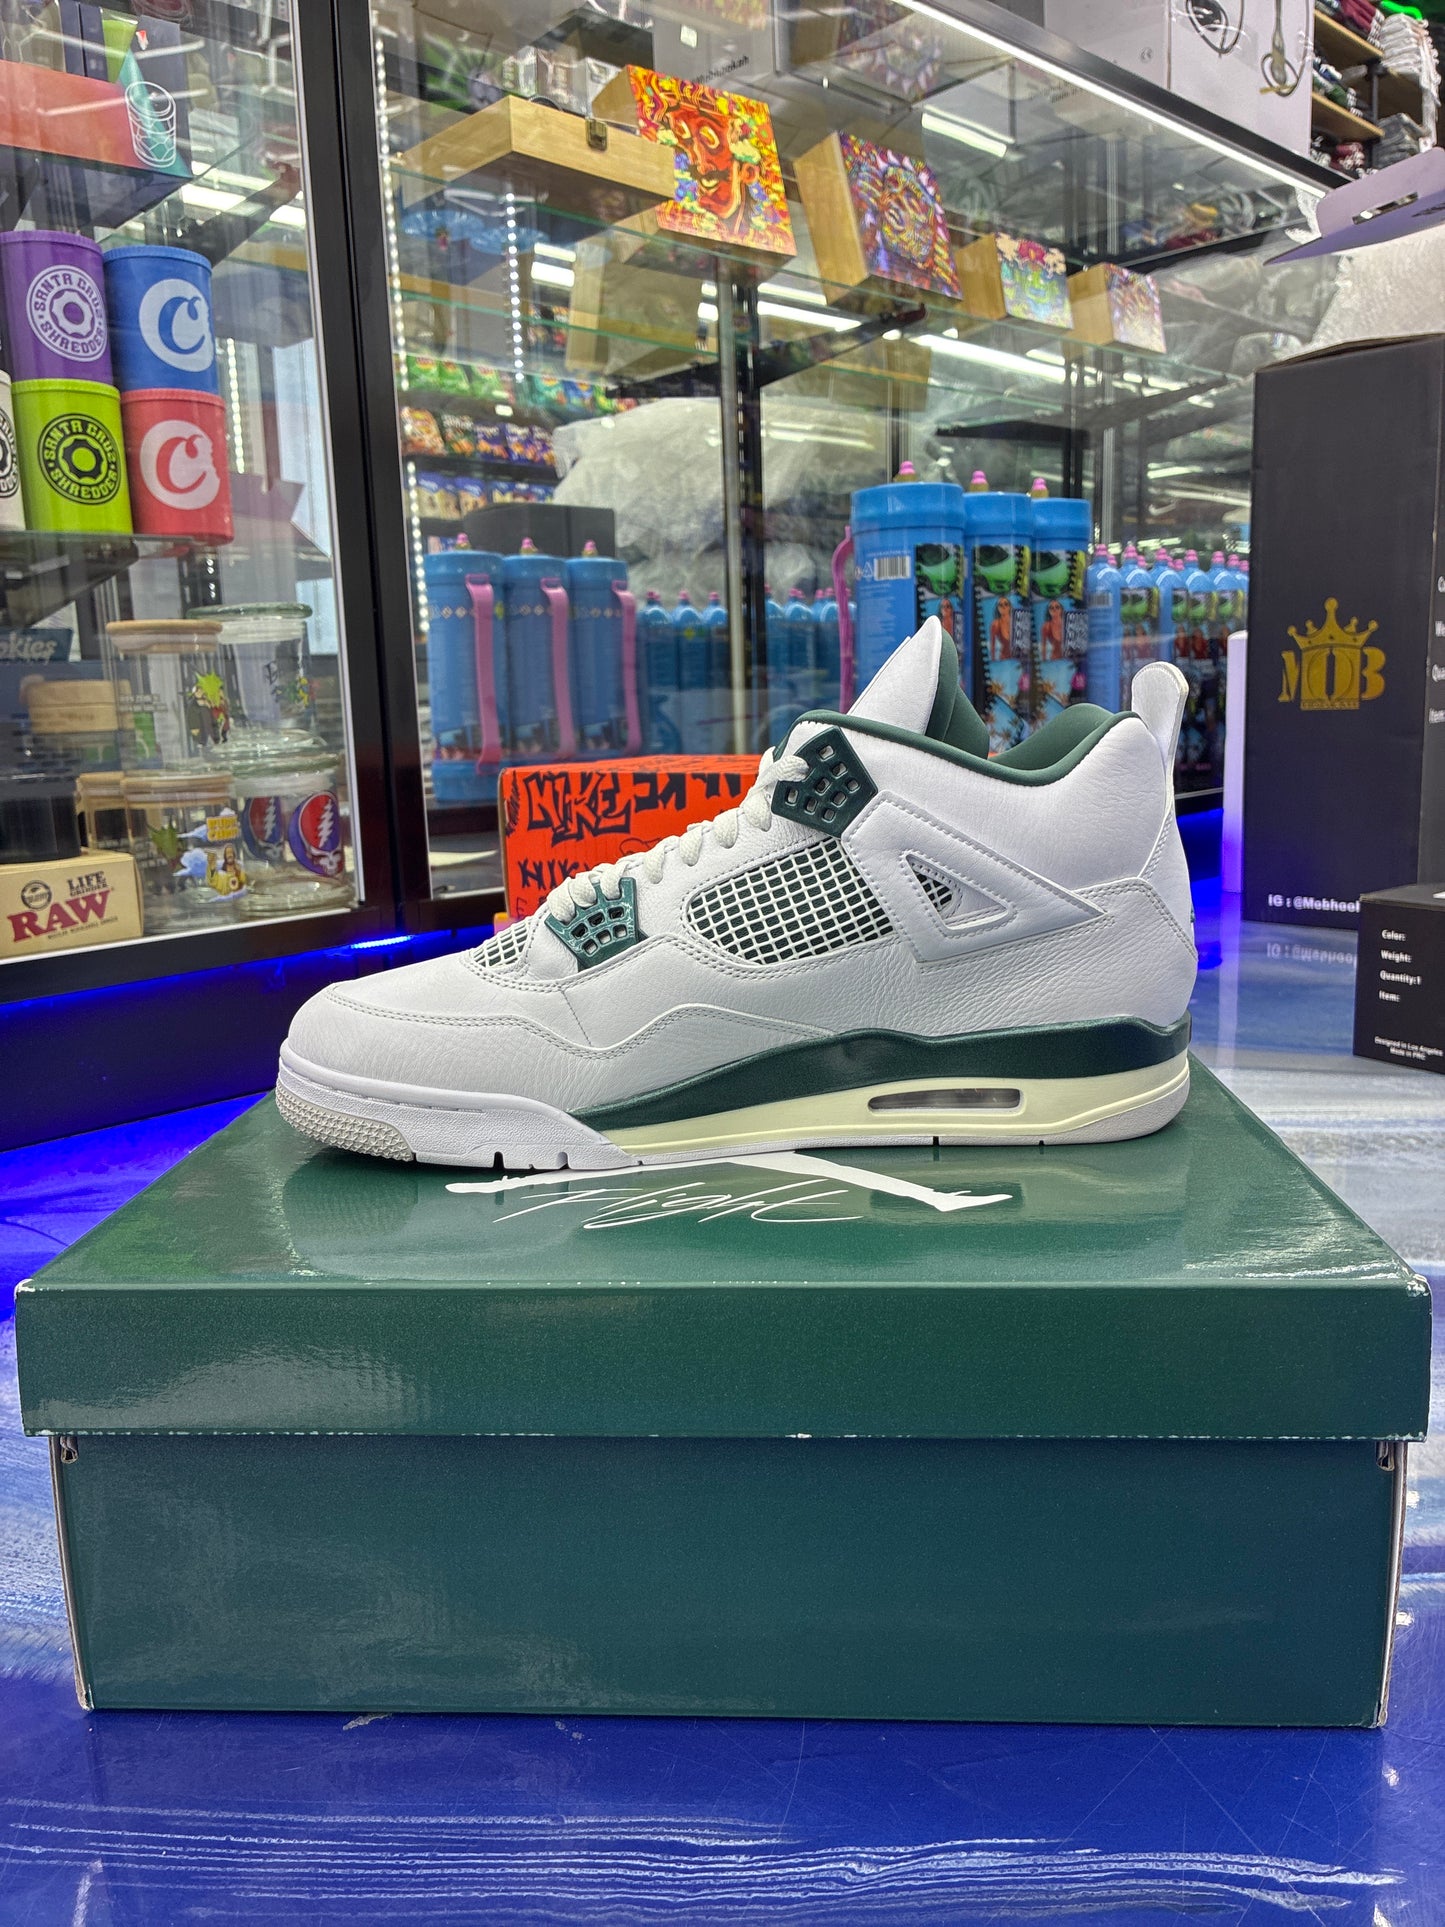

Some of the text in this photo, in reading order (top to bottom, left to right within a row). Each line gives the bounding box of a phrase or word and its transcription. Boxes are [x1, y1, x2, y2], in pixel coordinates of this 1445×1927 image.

[33, 272, 74, 313] SANTA
[40, 320, 105, 355] SHREDDER
[43, 419, 83, 461] SANTA
[50, 467, 119, 499] SHREDDER
[67, 870, 106, 889] LIFE
[1268, 893, 1284, 907] IG
[7, 890, 111, 942] RAW
[1381, 929, 1406, 942] Color:
[1380, 949, 1413, 964] Weight:
[1378, 989, 1401, 1003] Item:
